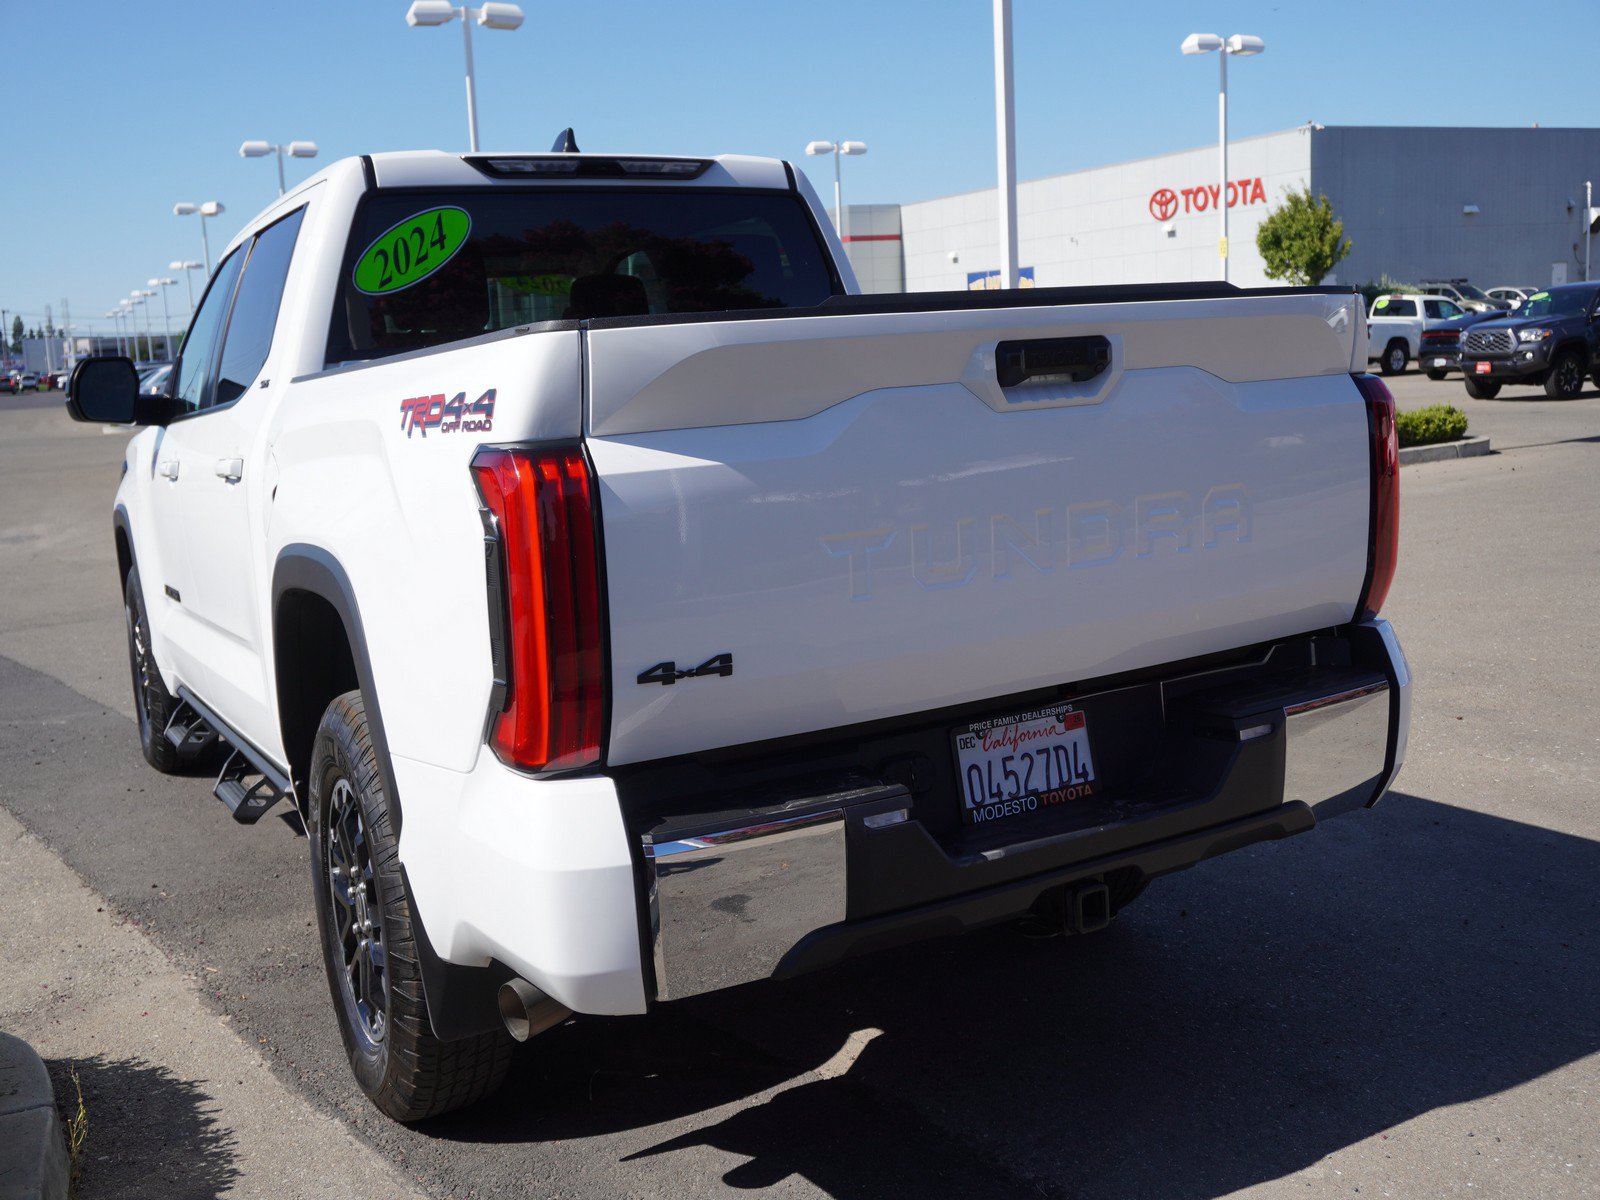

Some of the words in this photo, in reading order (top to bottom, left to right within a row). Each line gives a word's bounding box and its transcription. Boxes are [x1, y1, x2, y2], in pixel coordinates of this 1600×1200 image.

[1180, 177, 1267, 213] TOYOTA
[373, 211, 447, 290] 2024
[400, 393, 445, 439] TRD
[441, 421, 461, 433] OFF
[461, 419, 492, 432] ROAD
[818, 482, 1254, 601] TUNDRA
[969, 719, 992, 732] PRICE
[993, 714, 1021, 728] FAMILY
[1021, 704, 1073, 721] DEALERSHIPS
[982, 719, 1066, 752] California
[959, 736, 976, 750] DEC
[967, 741, 1089, 806] 04527D4
[973, 796, 1037, 824] MODESTO
[1040, 785, 1093, 806] TOYOTA
